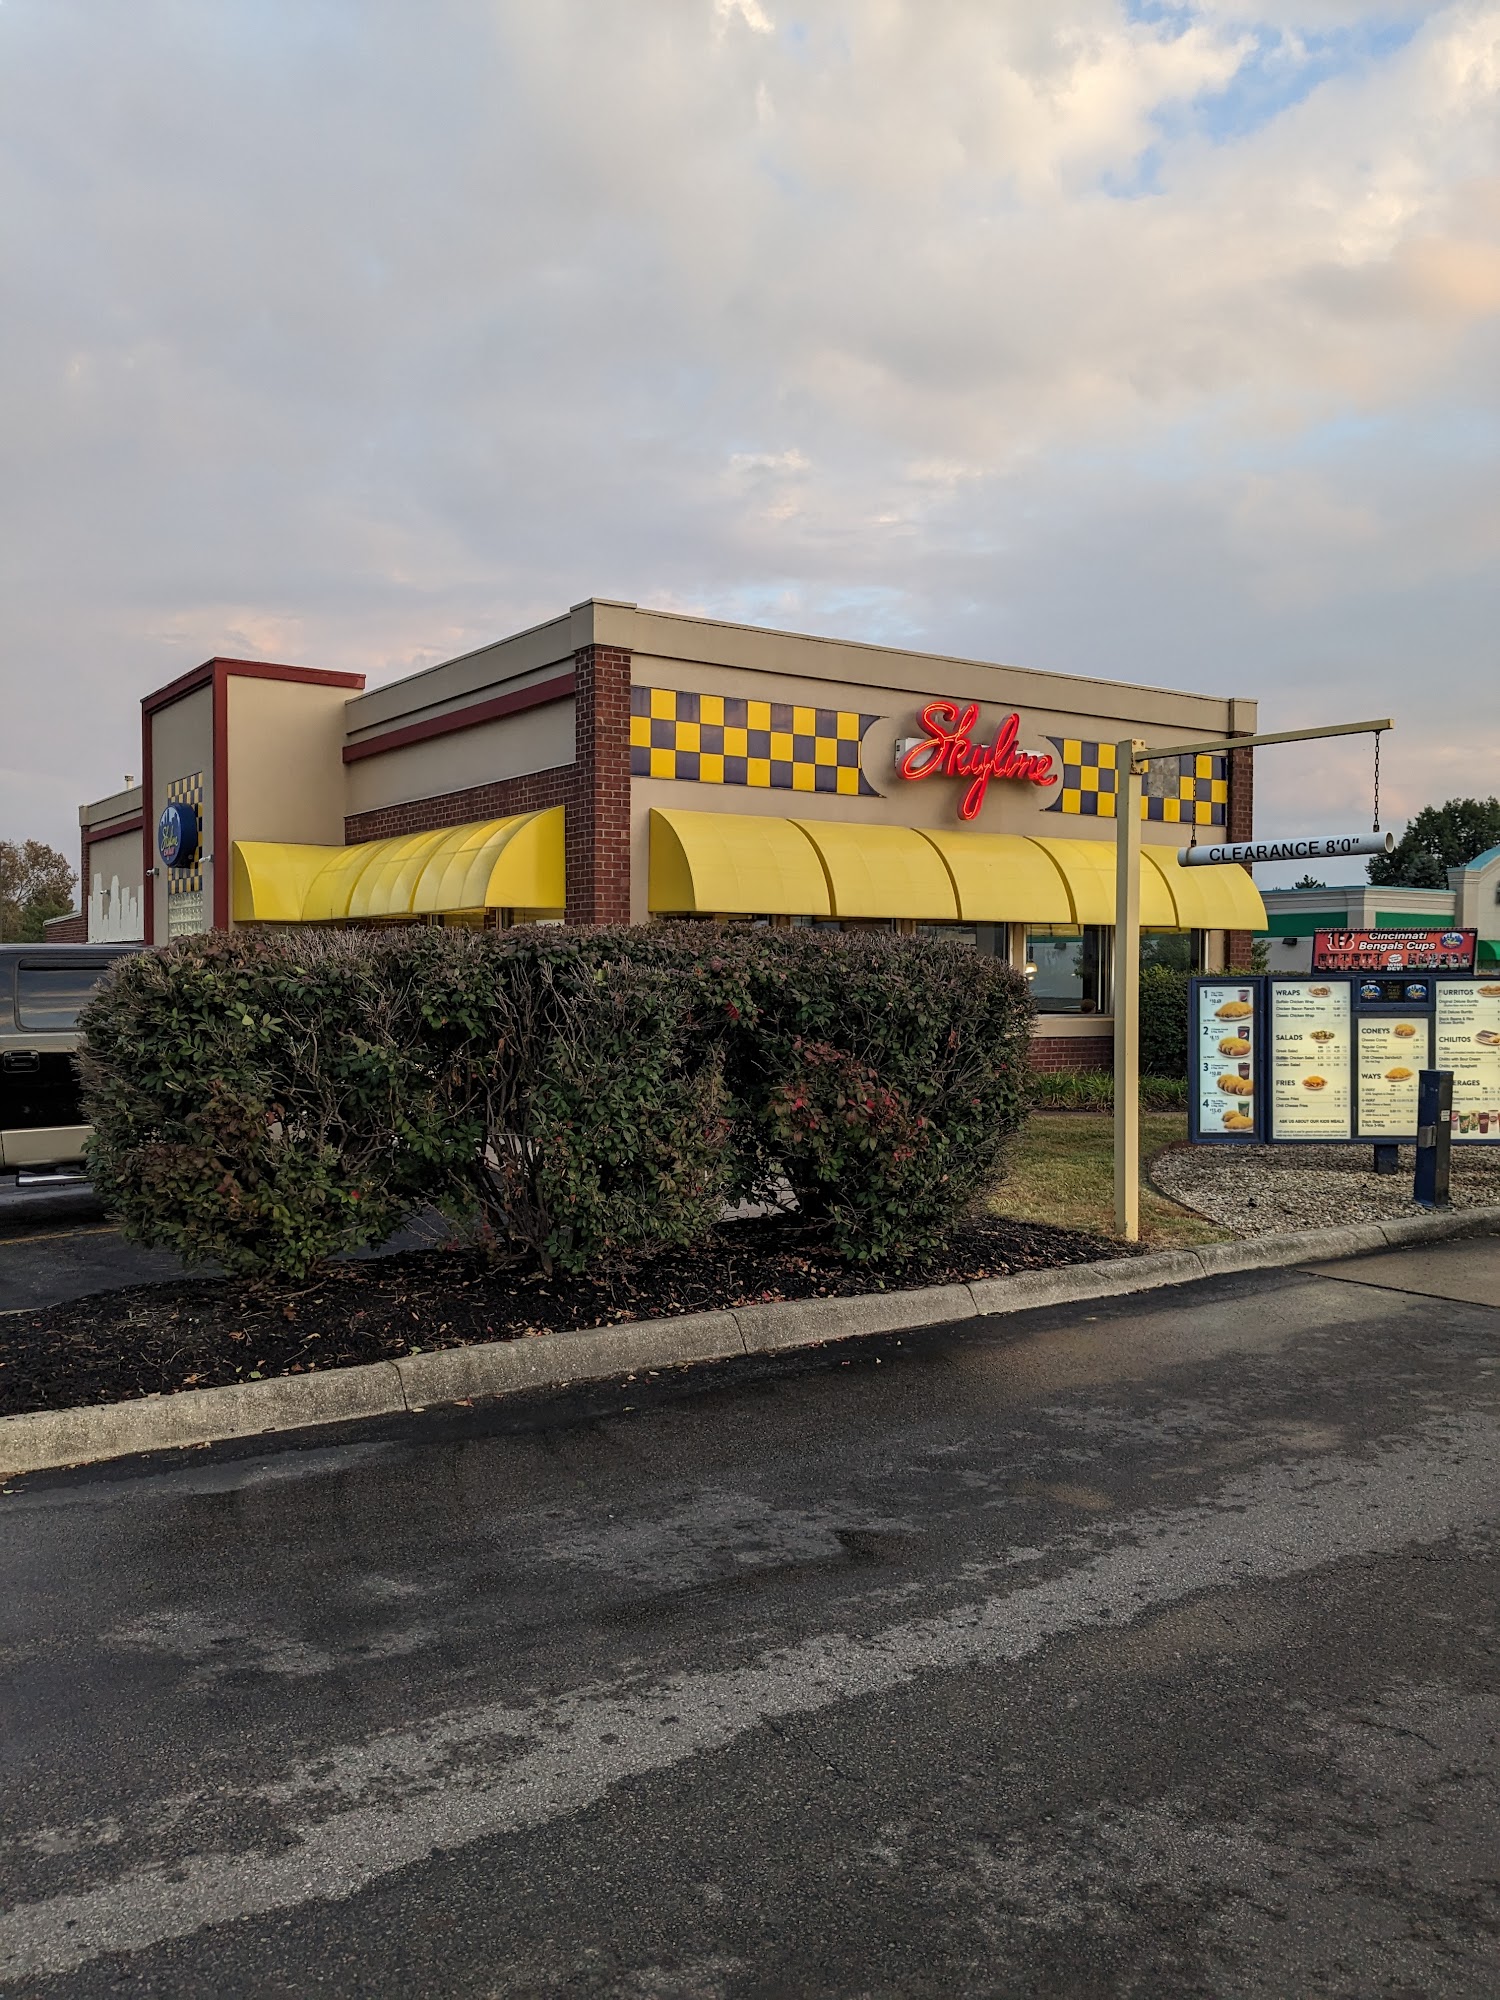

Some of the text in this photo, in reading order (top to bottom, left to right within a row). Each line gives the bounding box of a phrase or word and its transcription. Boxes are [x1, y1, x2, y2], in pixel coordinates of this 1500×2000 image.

[895, 702, 1058, 820] Skyline
[1209, 838, 1360, 861] CLEARANCE 8'0"
[1358, 942, 1404, 952] Bengals
[1406, 942, 1436, 951] Cups
[1203, 990, 1208, 999] 1
[1203, 1026, 1209, 1035] 2
[1203, 1062, 1209, 1071] 3
[1202, 1099, 1209, 1107] 4
